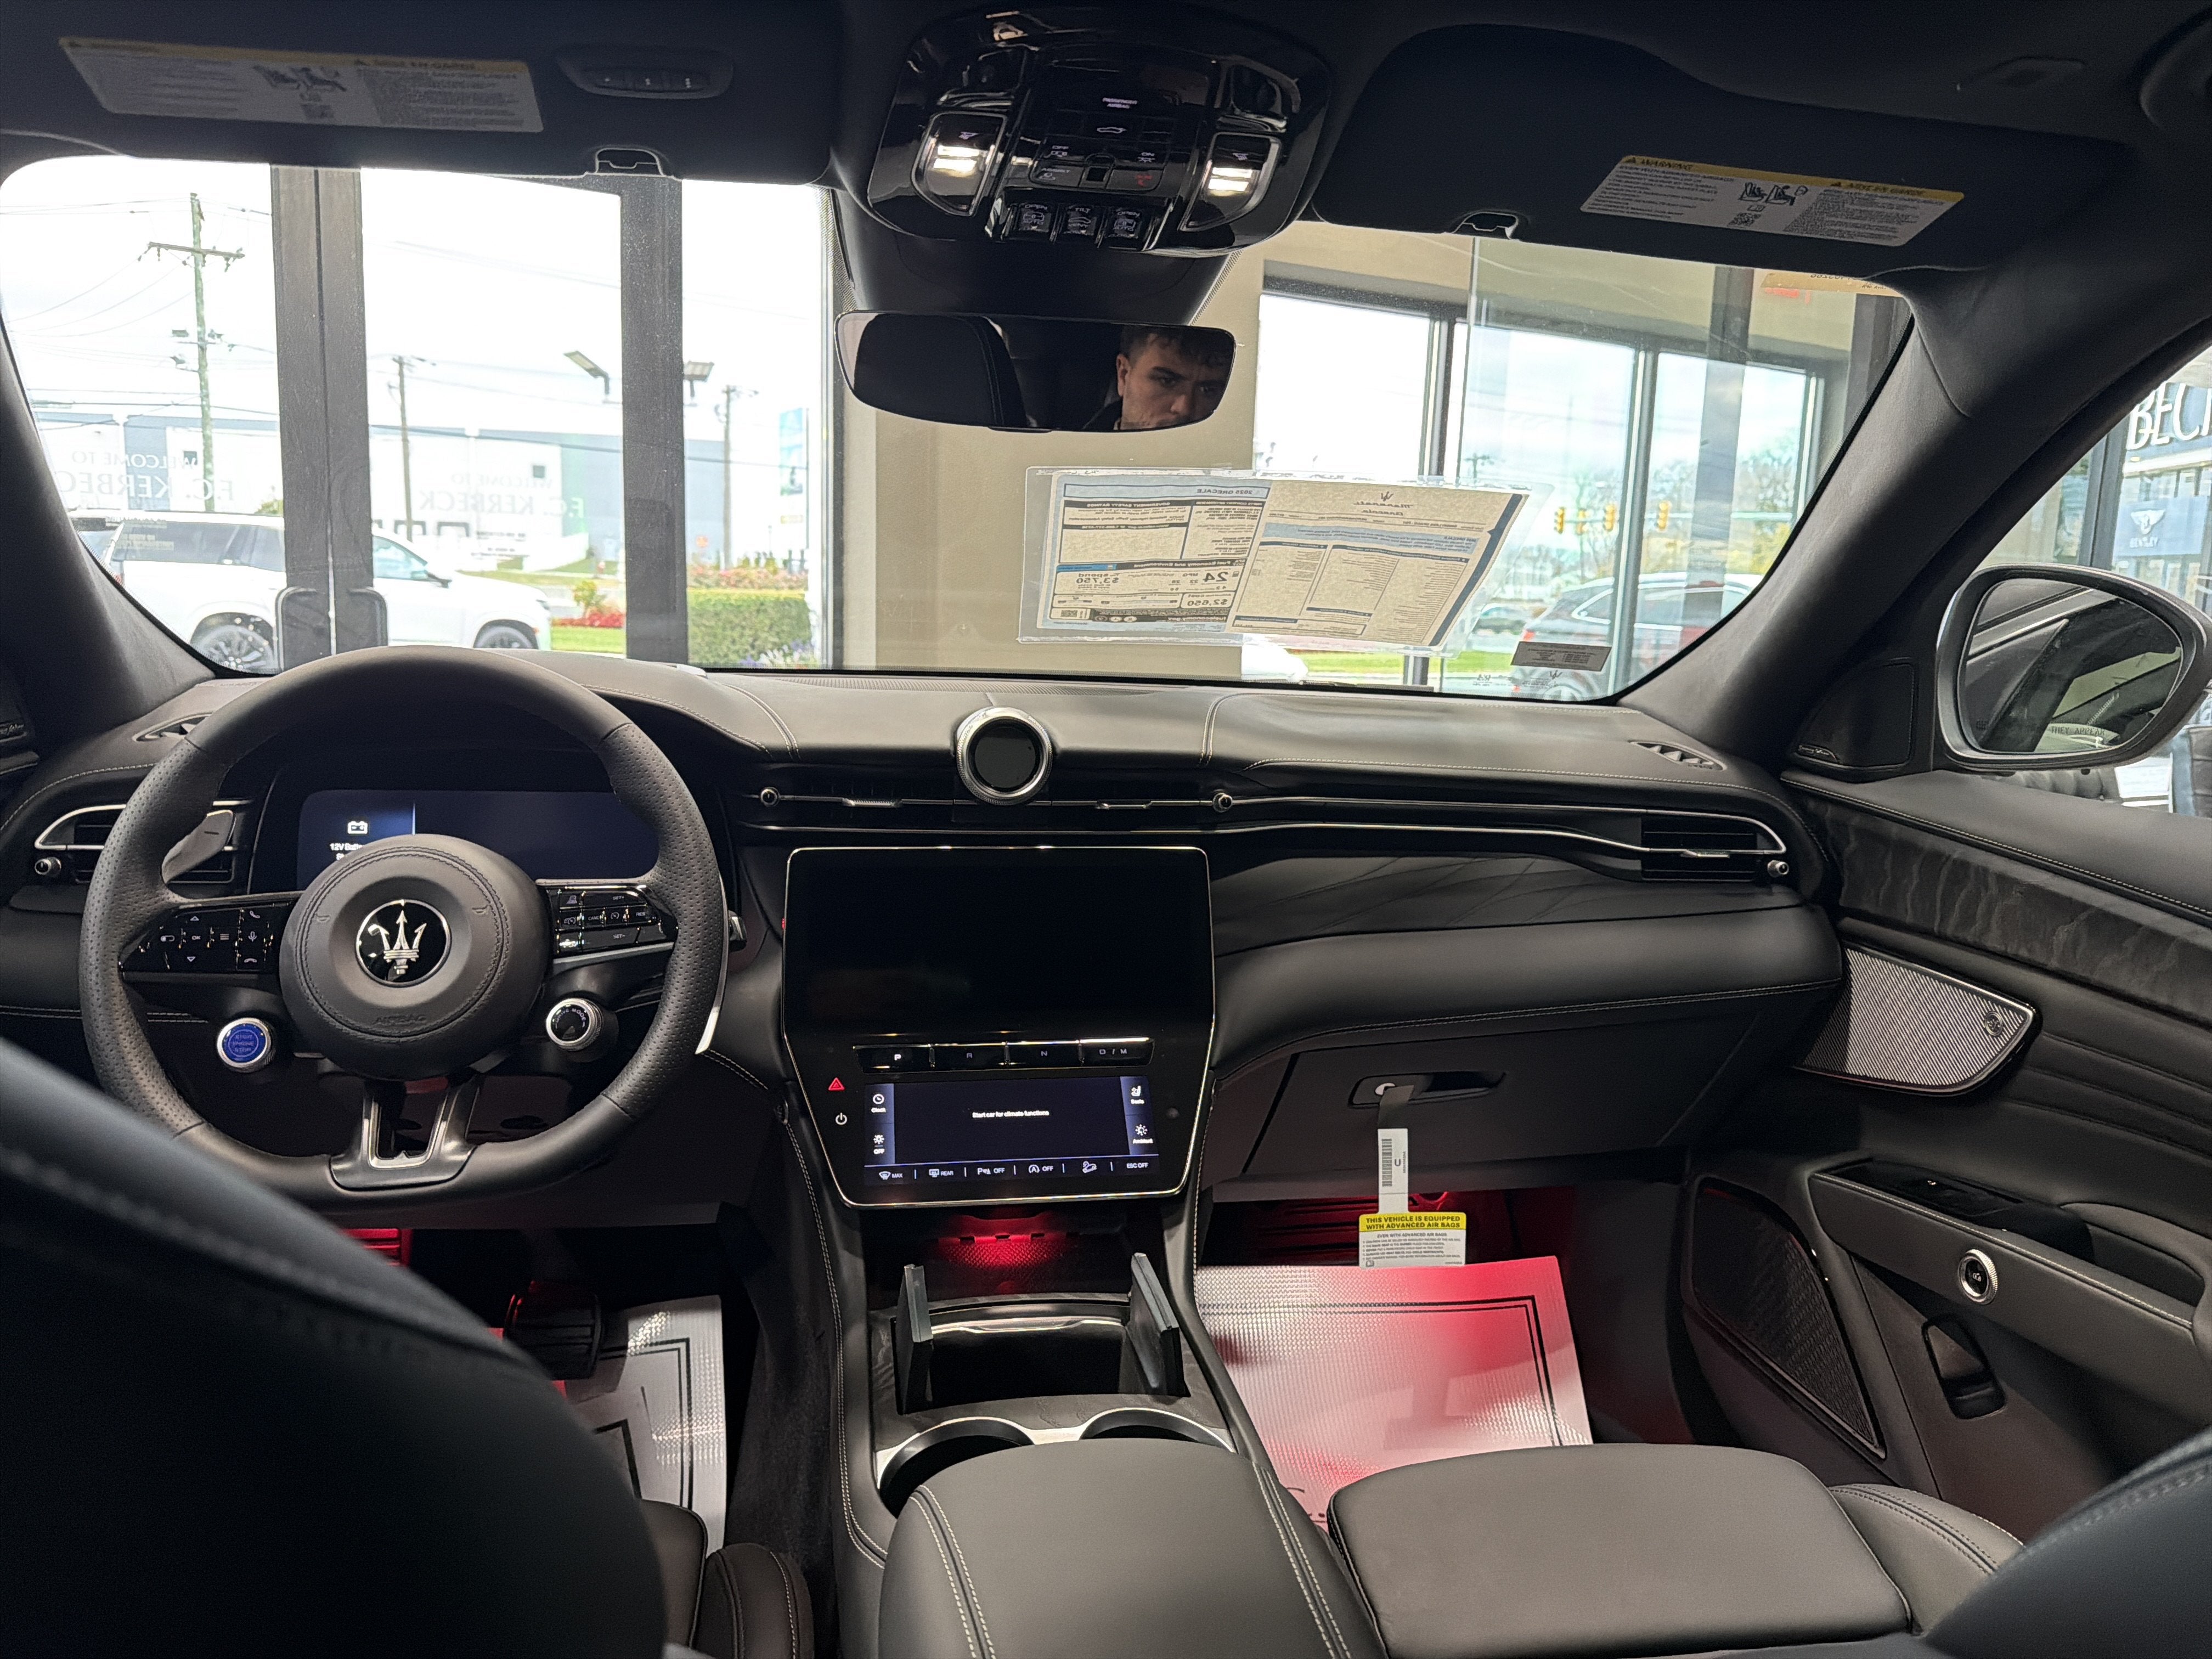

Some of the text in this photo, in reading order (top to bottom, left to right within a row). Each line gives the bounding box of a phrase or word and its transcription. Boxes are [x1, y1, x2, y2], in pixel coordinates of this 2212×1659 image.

[2126, 382, 2212, 450] BEC
[2051, 726, 2105, 736] THEY APPEAR
[571, 1008, 586, 1021] MODE
